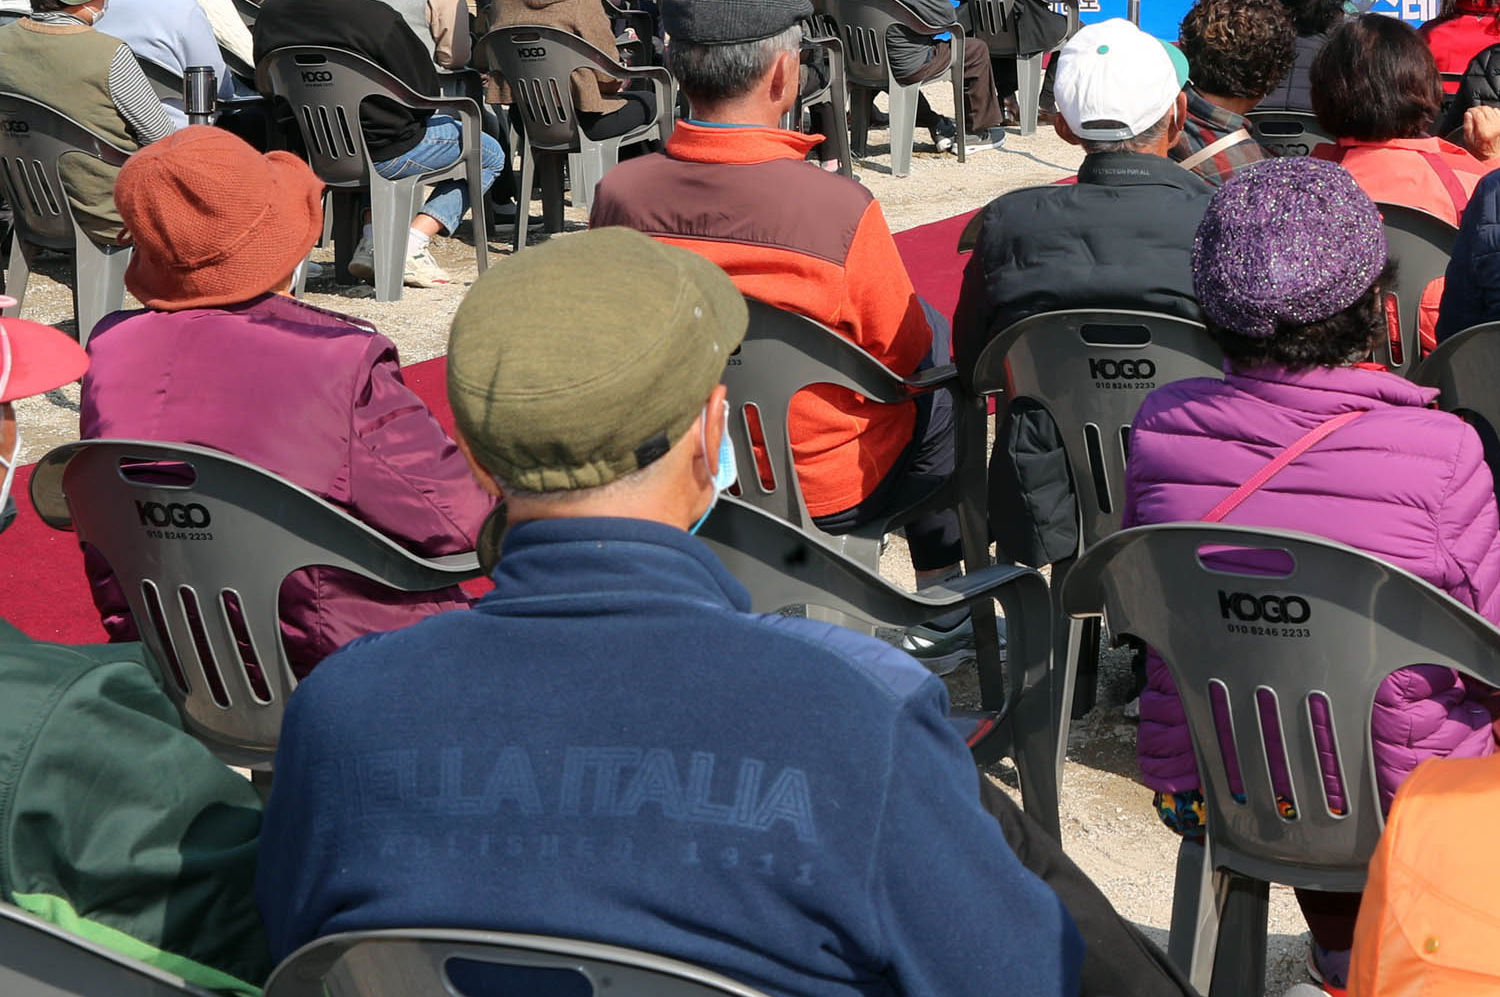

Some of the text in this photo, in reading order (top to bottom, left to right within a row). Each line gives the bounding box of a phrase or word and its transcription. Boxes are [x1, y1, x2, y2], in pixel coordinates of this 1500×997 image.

[1088, 358, 1156, 380] KOGO
[1135, 381, 1156, 389] 2233
[135, 499, 211, 529] KOGO
[188, 532, 213, 541] 2233
[1218, 590, 1312, 624] KOGO
[1227, 624, 1311, 638] 010 8246 2233
[558, 745, 819, 845] ITALIA
